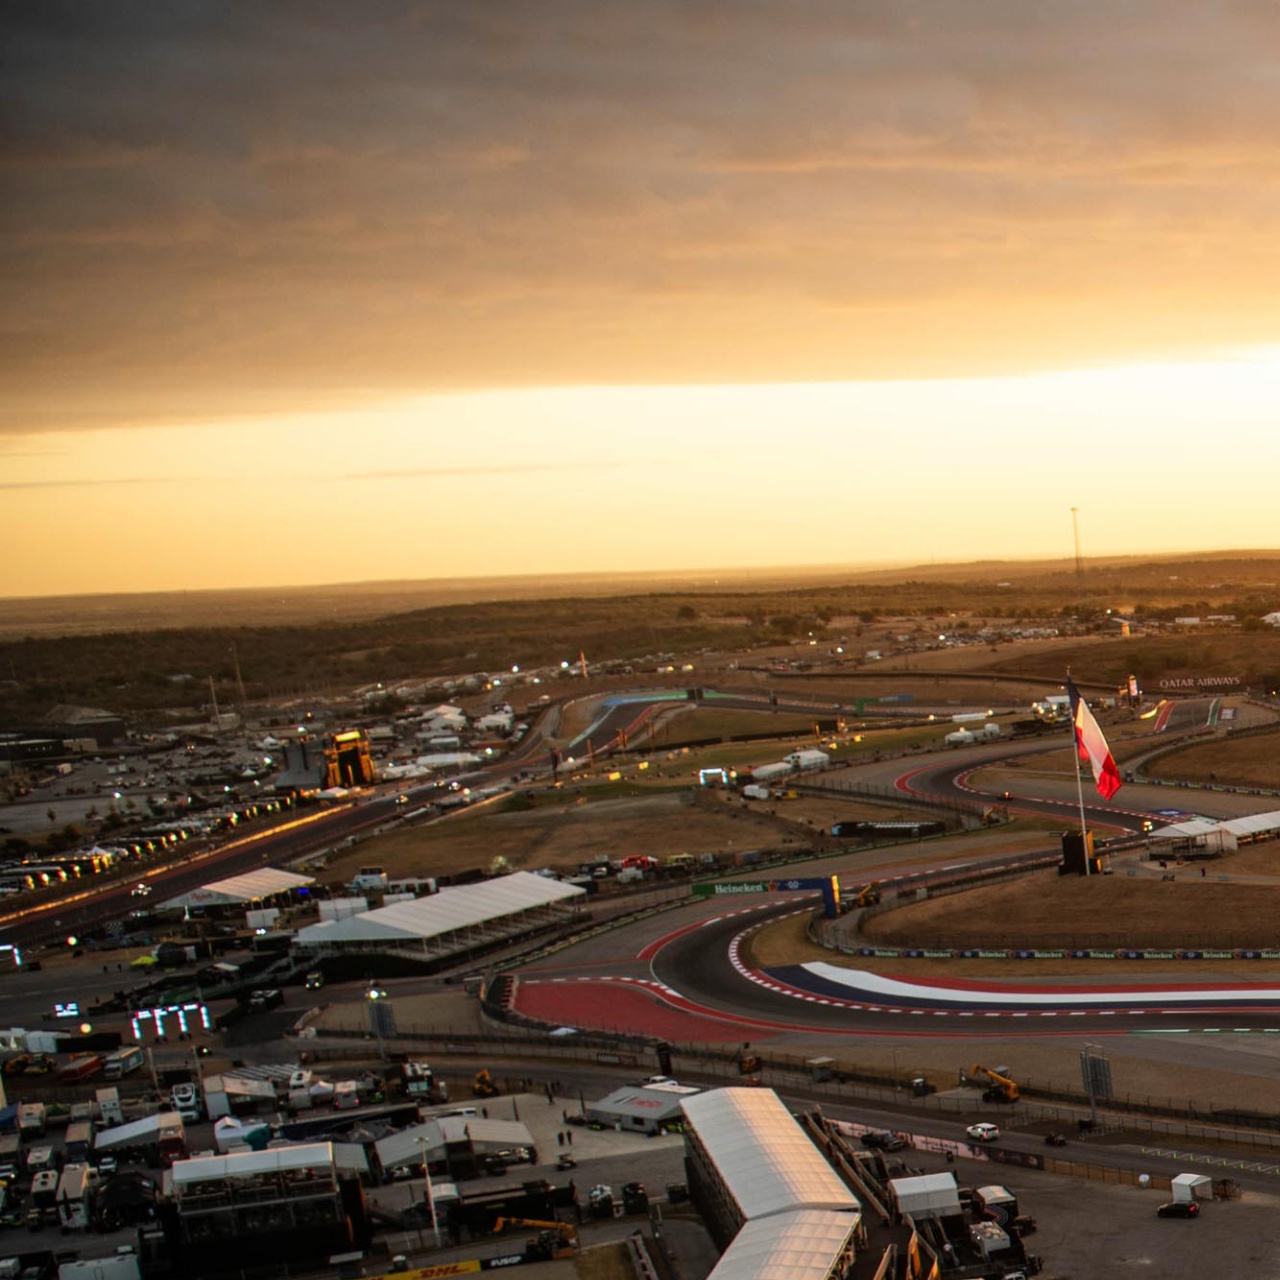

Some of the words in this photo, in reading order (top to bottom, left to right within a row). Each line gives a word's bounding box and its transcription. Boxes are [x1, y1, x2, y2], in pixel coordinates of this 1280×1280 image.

[1159, 678, 1194, 689] QATAR
[1197, 677, 1240, 687] AIRWAYS
[714, 882, 763, 894] Heineken
[421, 1265, 462, 1278] DHL
